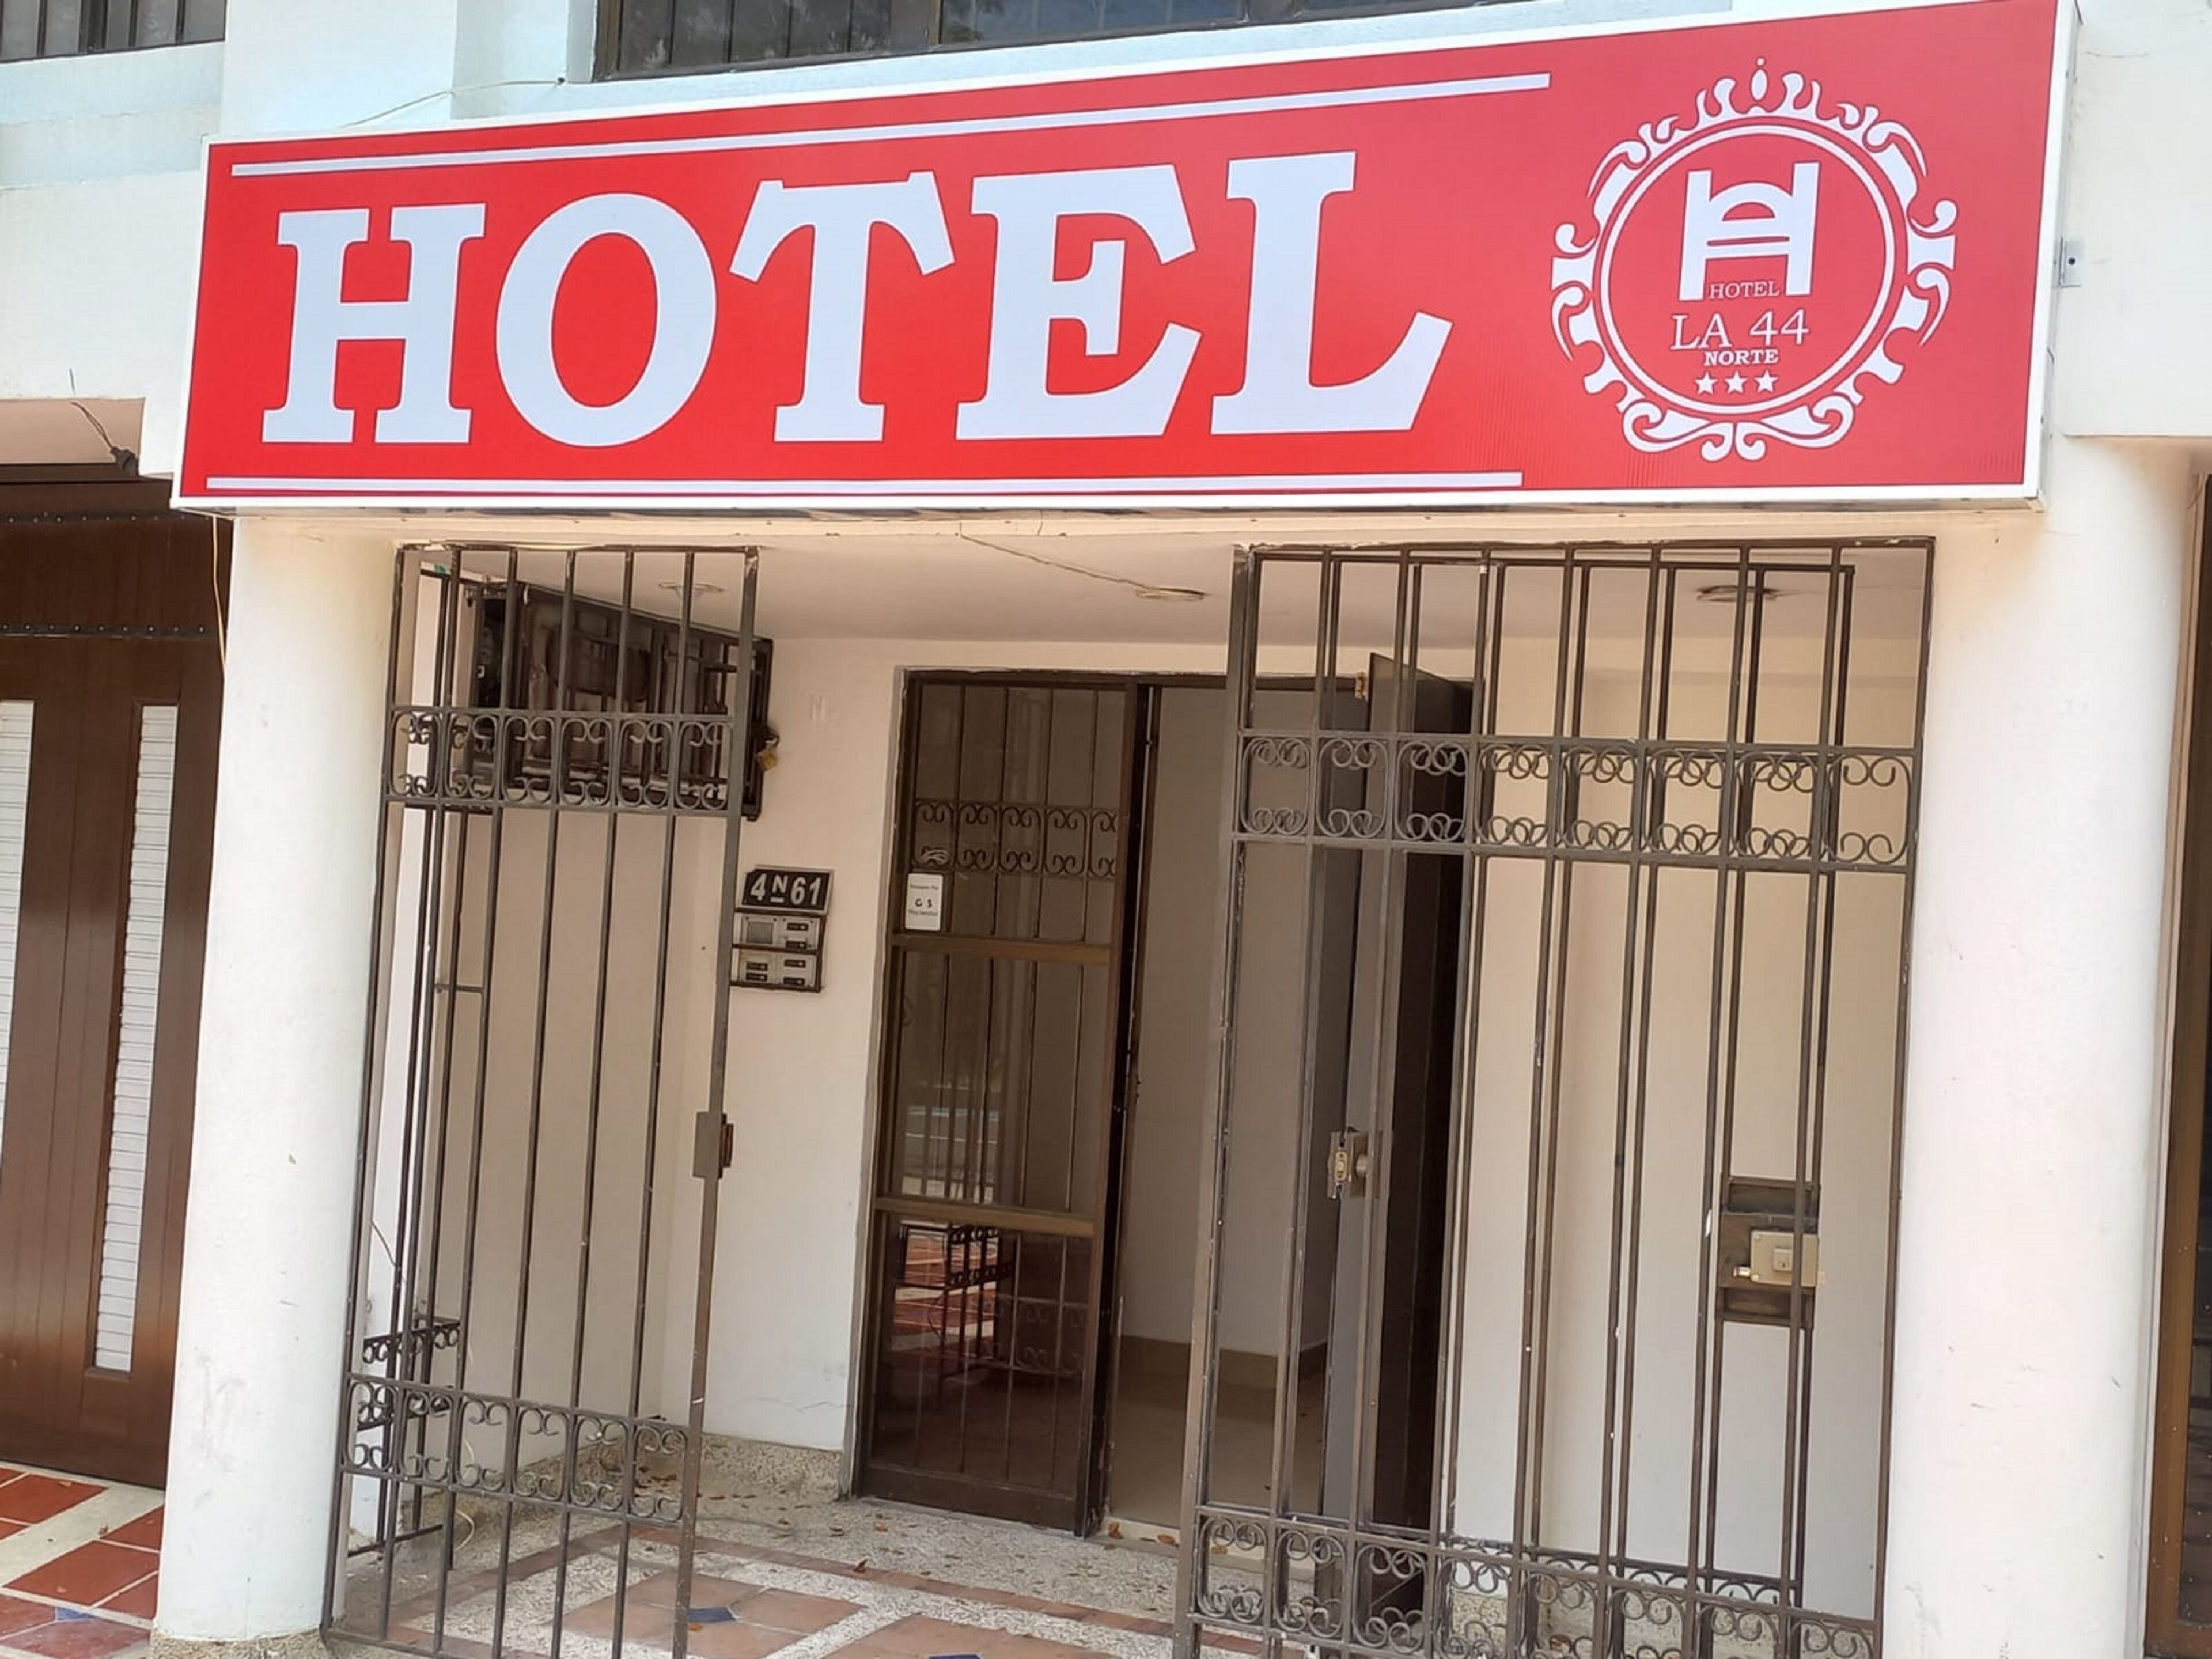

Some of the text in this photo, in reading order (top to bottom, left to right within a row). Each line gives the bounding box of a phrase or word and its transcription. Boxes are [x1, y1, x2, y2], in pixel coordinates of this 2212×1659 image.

[262, 150, 1453, 447] HOTEL
[1709, 281, 1779, 299] HOTEL
[1671, 309, 1809, 350] LA 44
[1703, 349, 1779, 366] NORTE
